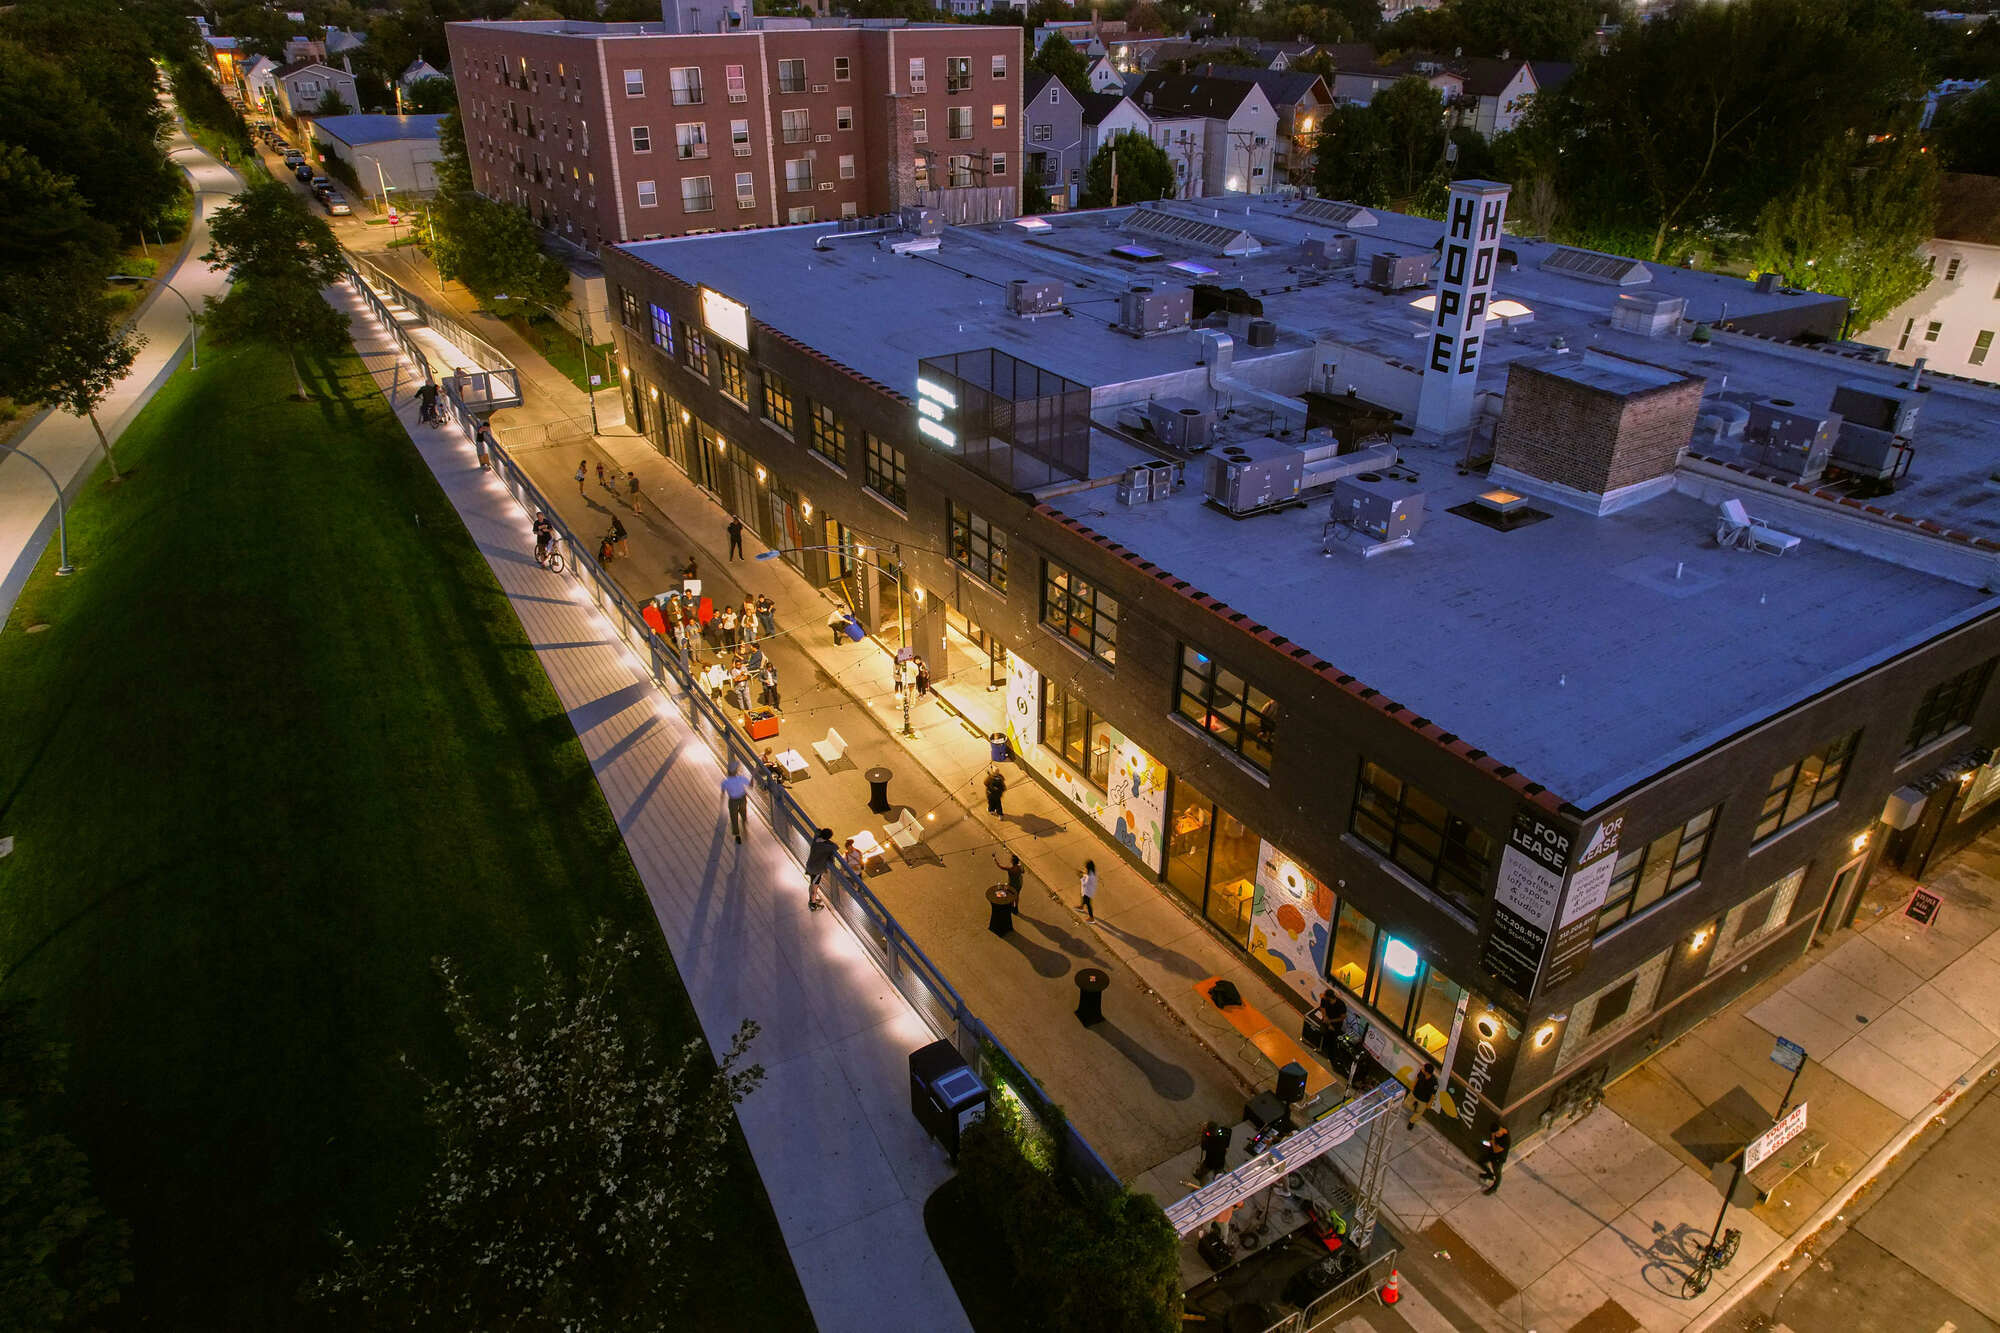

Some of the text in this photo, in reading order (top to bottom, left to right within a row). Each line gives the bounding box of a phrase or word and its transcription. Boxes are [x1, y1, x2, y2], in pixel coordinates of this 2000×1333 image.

[1431, 198, 1475, 374] HOPE
[1458, 199, 1502, 375] HOPE
[1512, 828, 1565, 869] LEASE
[1534, 822, 1569, 853] FOR
[1507, 874, 1551, 906] loft space
[1513, 870, 1549, 896] creative
[1510, 895, 1542, 919] studios
[1456, 1039, 1497, 1130] Ørkenoy
[1765, 1109, 1801, 1139] YOUR AD
